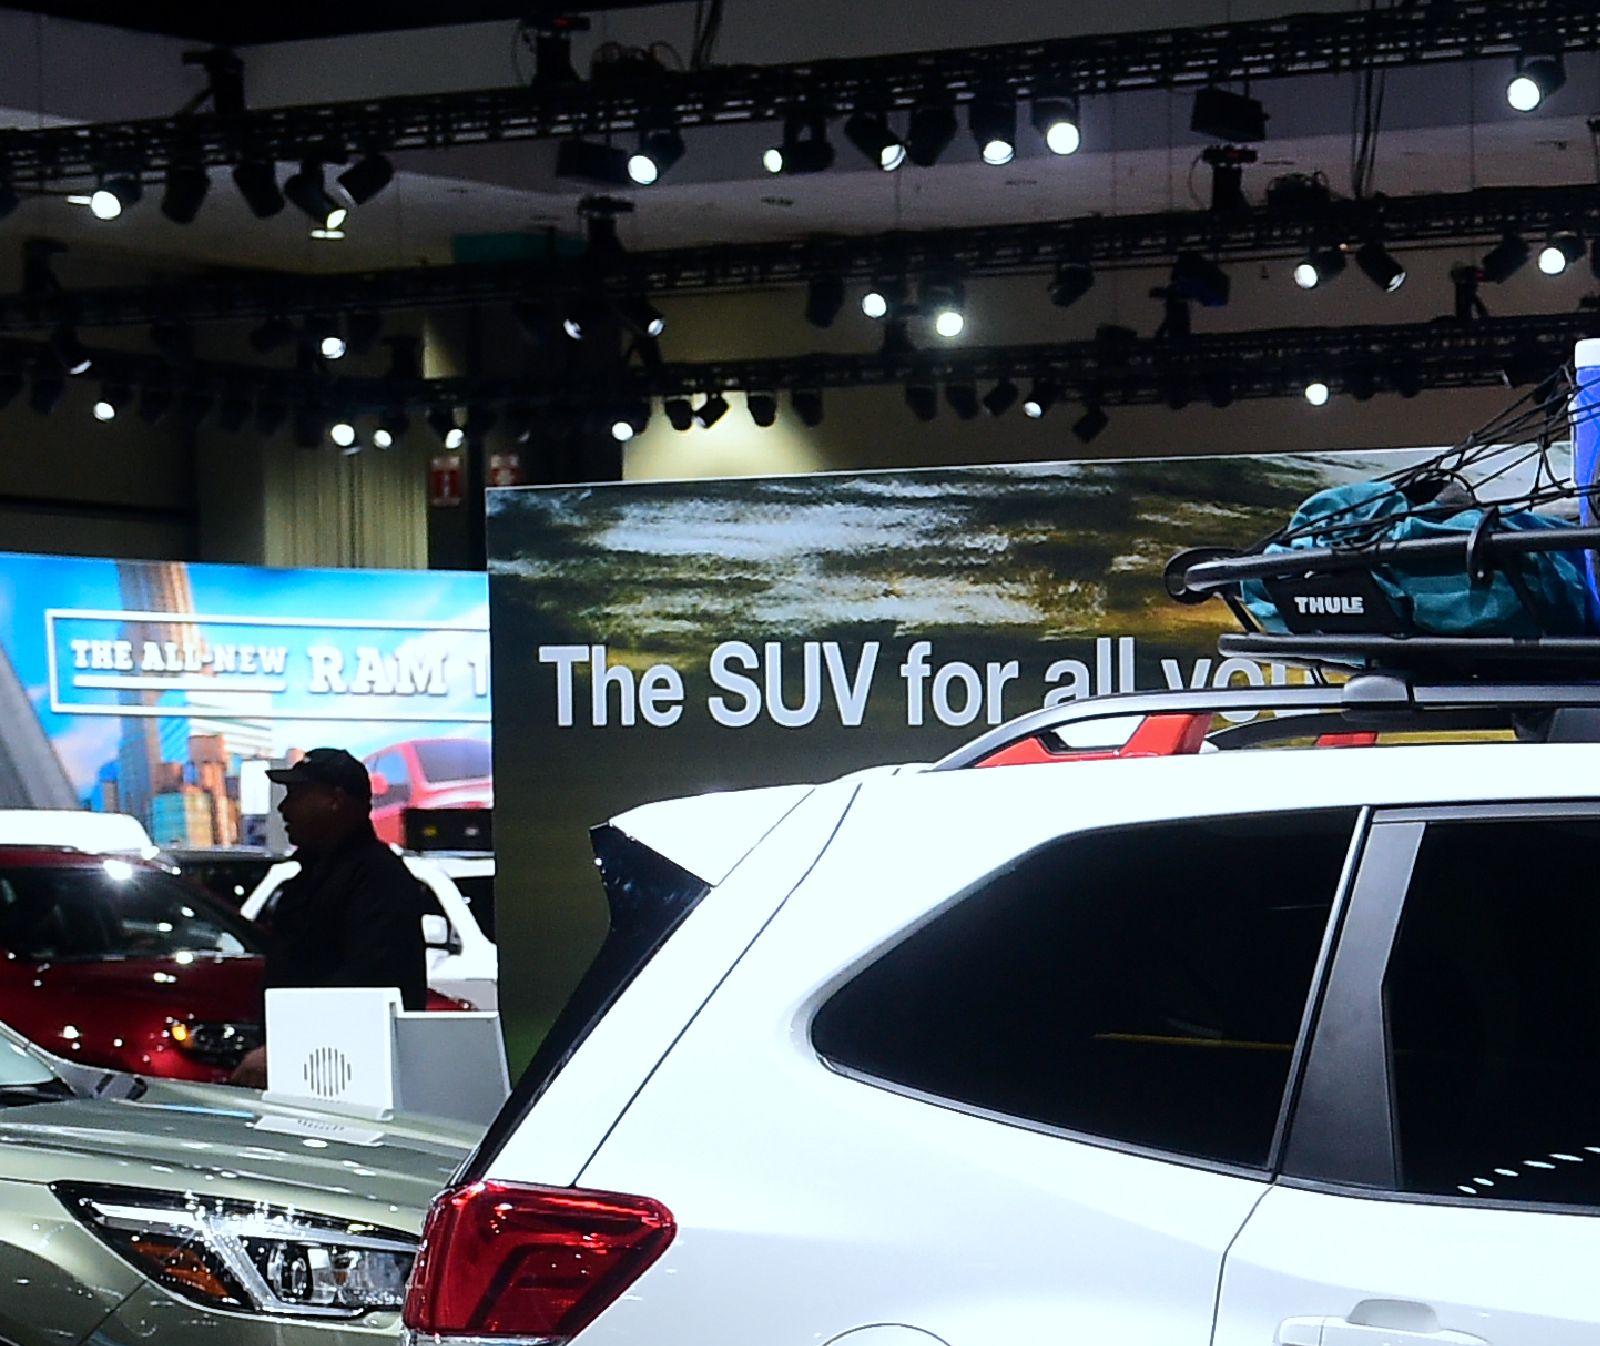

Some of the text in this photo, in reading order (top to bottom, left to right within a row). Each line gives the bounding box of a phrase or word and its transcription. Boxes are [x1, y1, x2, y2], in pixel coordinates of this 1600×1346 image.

[1294, 596, 1364, 614] THULE
[71, 639, 134, 670] THE
[141, 641, 288, 674] ALL-NEW
[308, 646, 449, 697] RAM
[538, 645, 685, 727] The
[708, 640, 880, 727] SUV
[901, 641, 1020, 727] for
[1044, 636, 1136, 708] all
